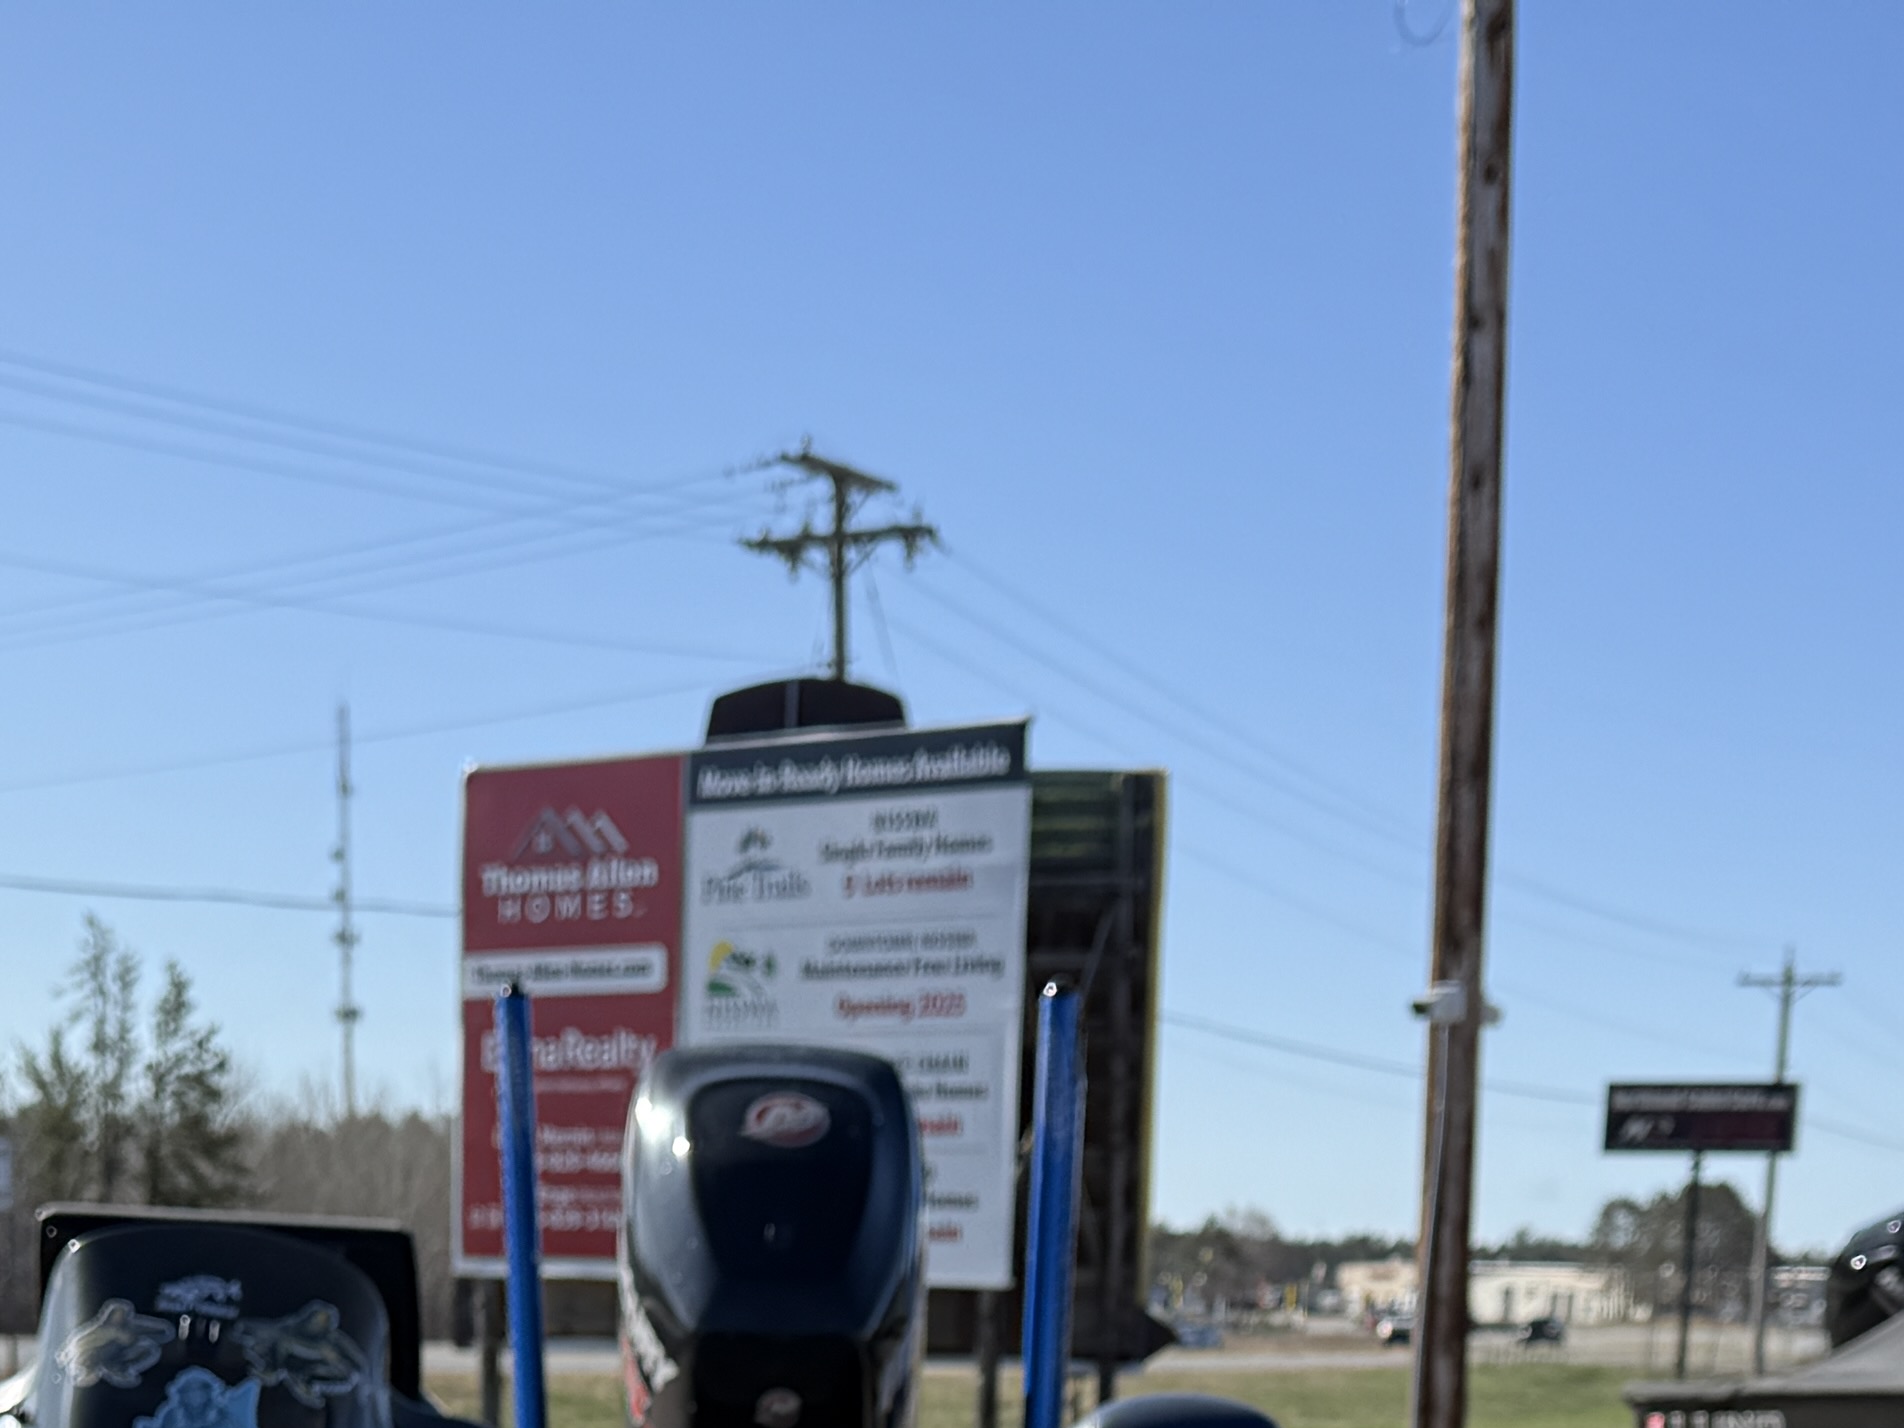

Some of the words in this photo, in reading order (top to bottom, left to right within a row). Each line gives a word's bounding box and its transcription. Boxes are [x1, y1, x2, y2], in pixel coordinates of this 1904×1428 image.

[481, 862, 583, 896] Thomas
[586, 855, 659, 889] Allen
[497, 891, 634, 924] HOMES
